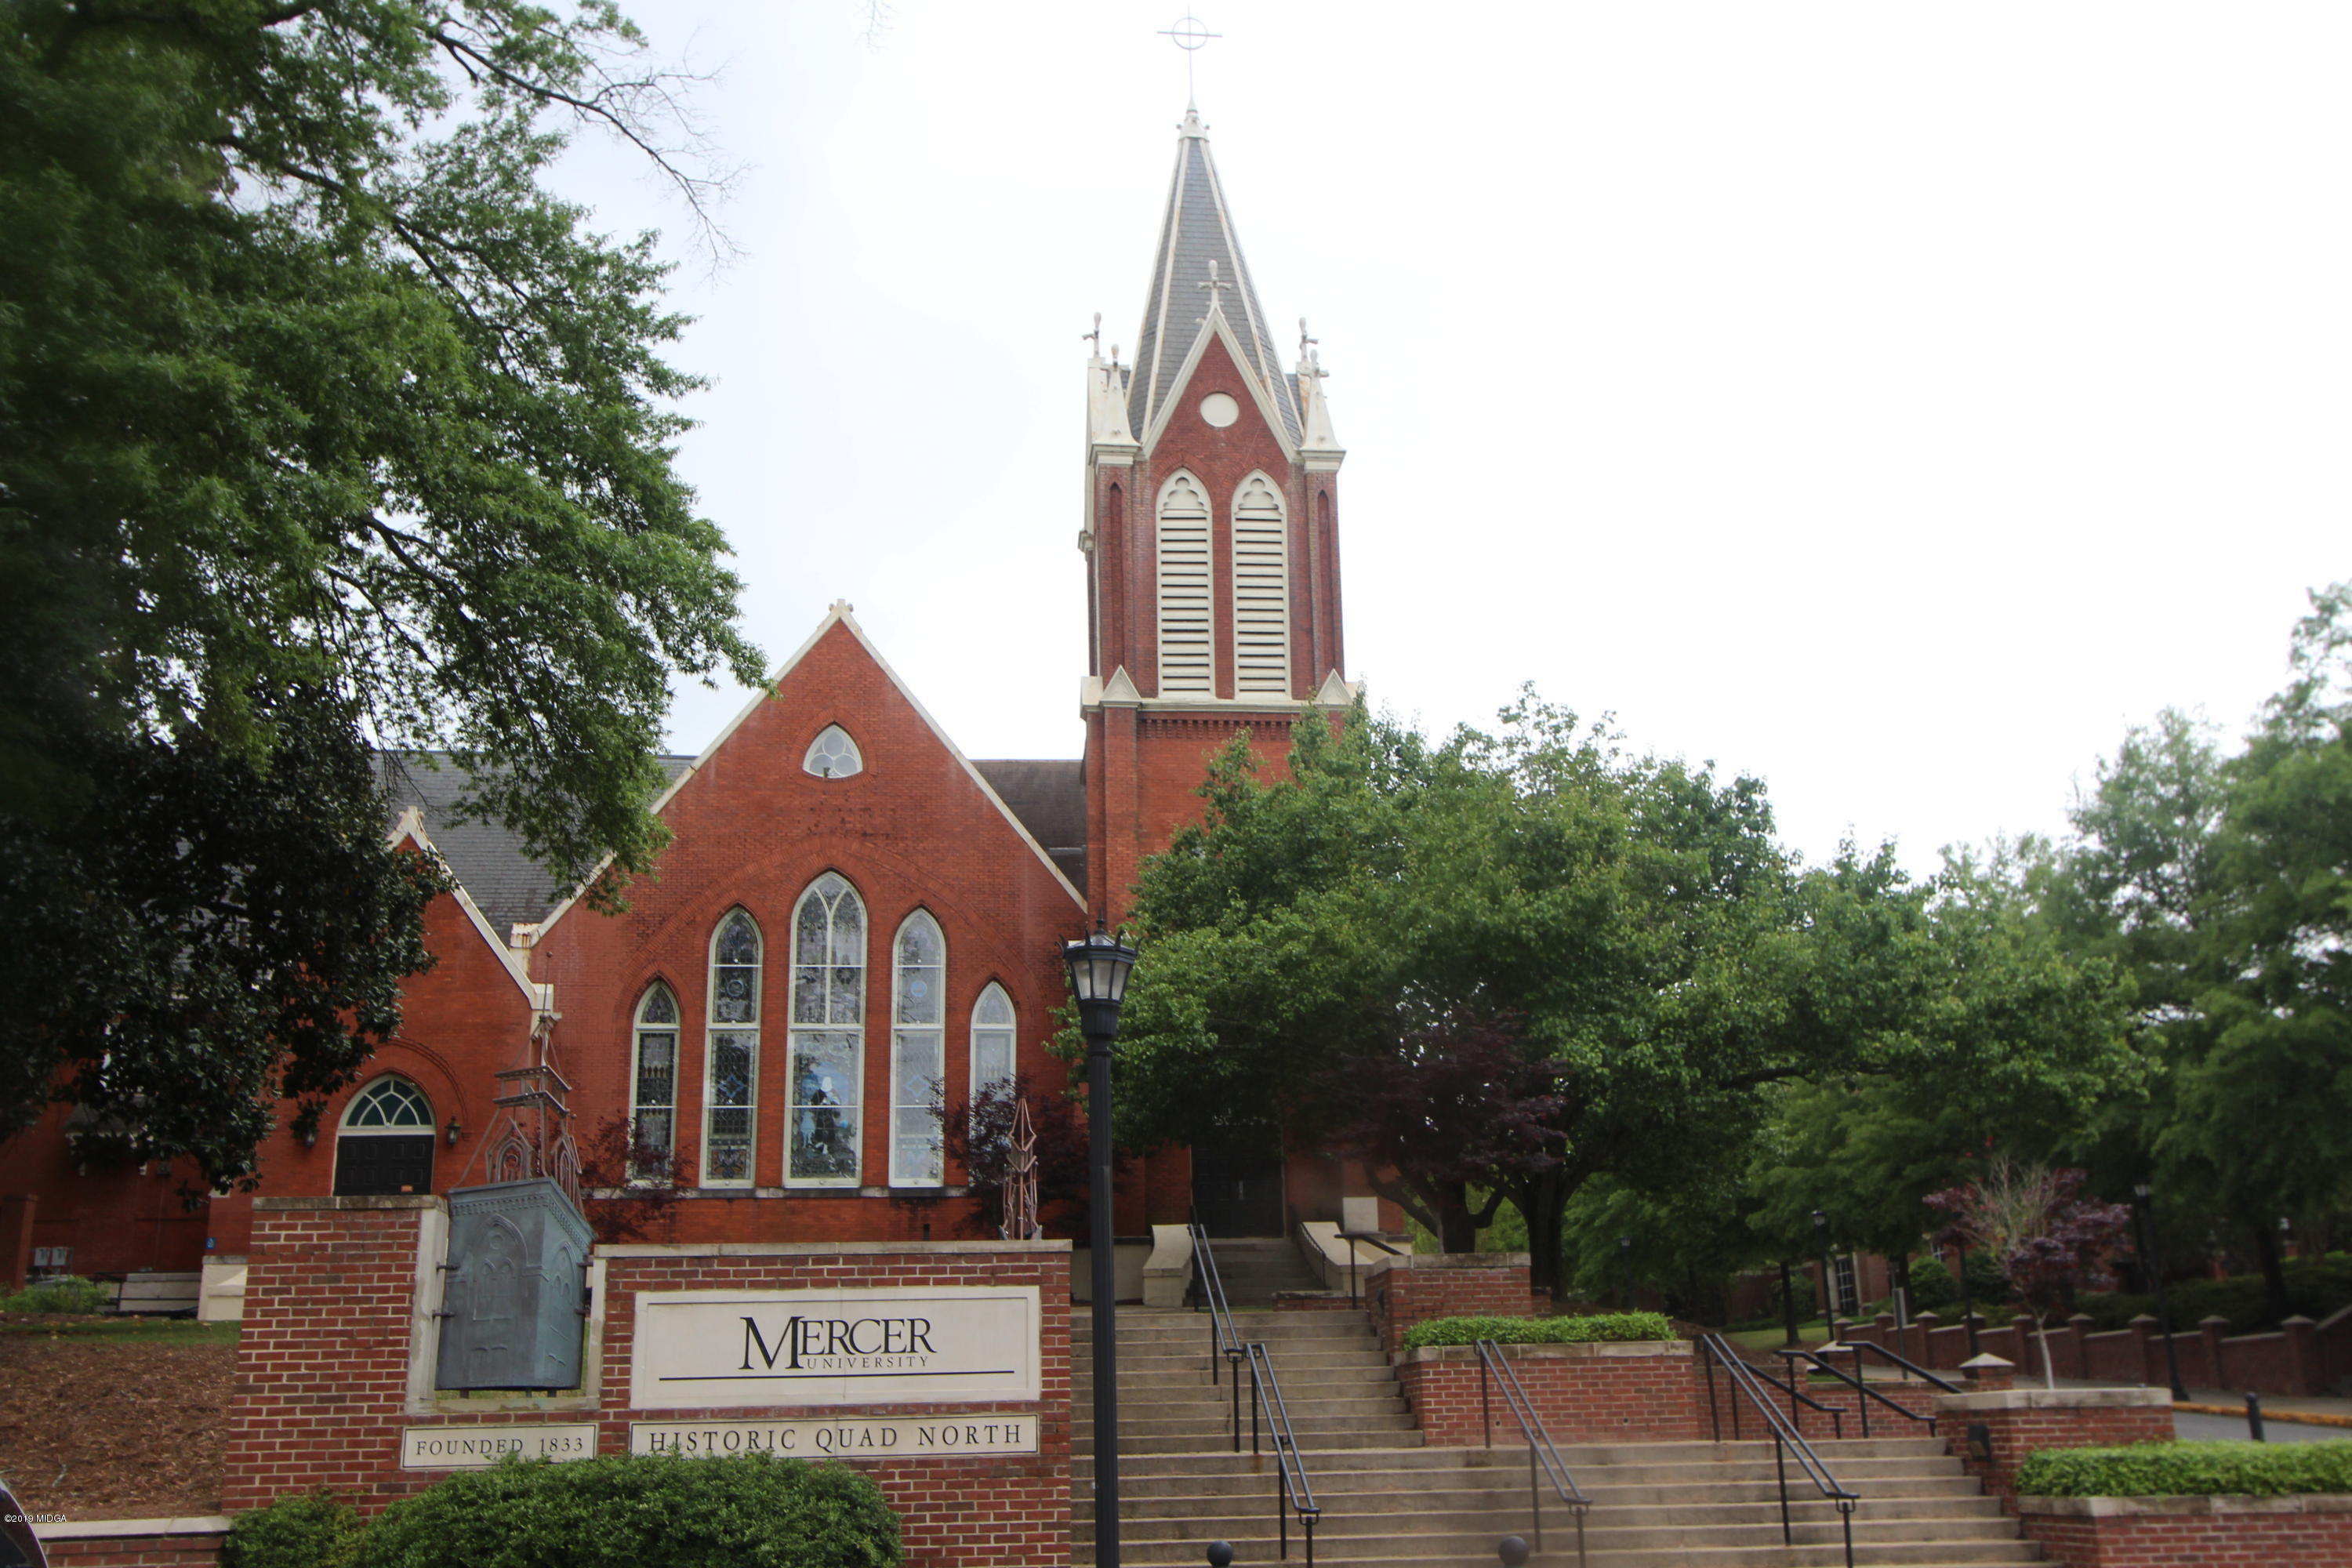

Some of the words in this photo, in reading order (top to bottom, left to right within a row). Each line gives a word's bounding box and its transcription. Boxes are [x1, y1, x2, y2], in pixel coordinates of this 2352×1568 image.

[739, 1316, 937, 1370] MERCER
[806, 1356, 928, 1370] UNIVERSITY
[416, 1439, 524, 1455] FOUNDED
[539, 1437, 583, 1452] 1833
[650, 1429, 795, 1451] HISTORIC
[815, 1427, 897, 1453] QUAD
[918, 1425, 1021, 1446] NORTH
